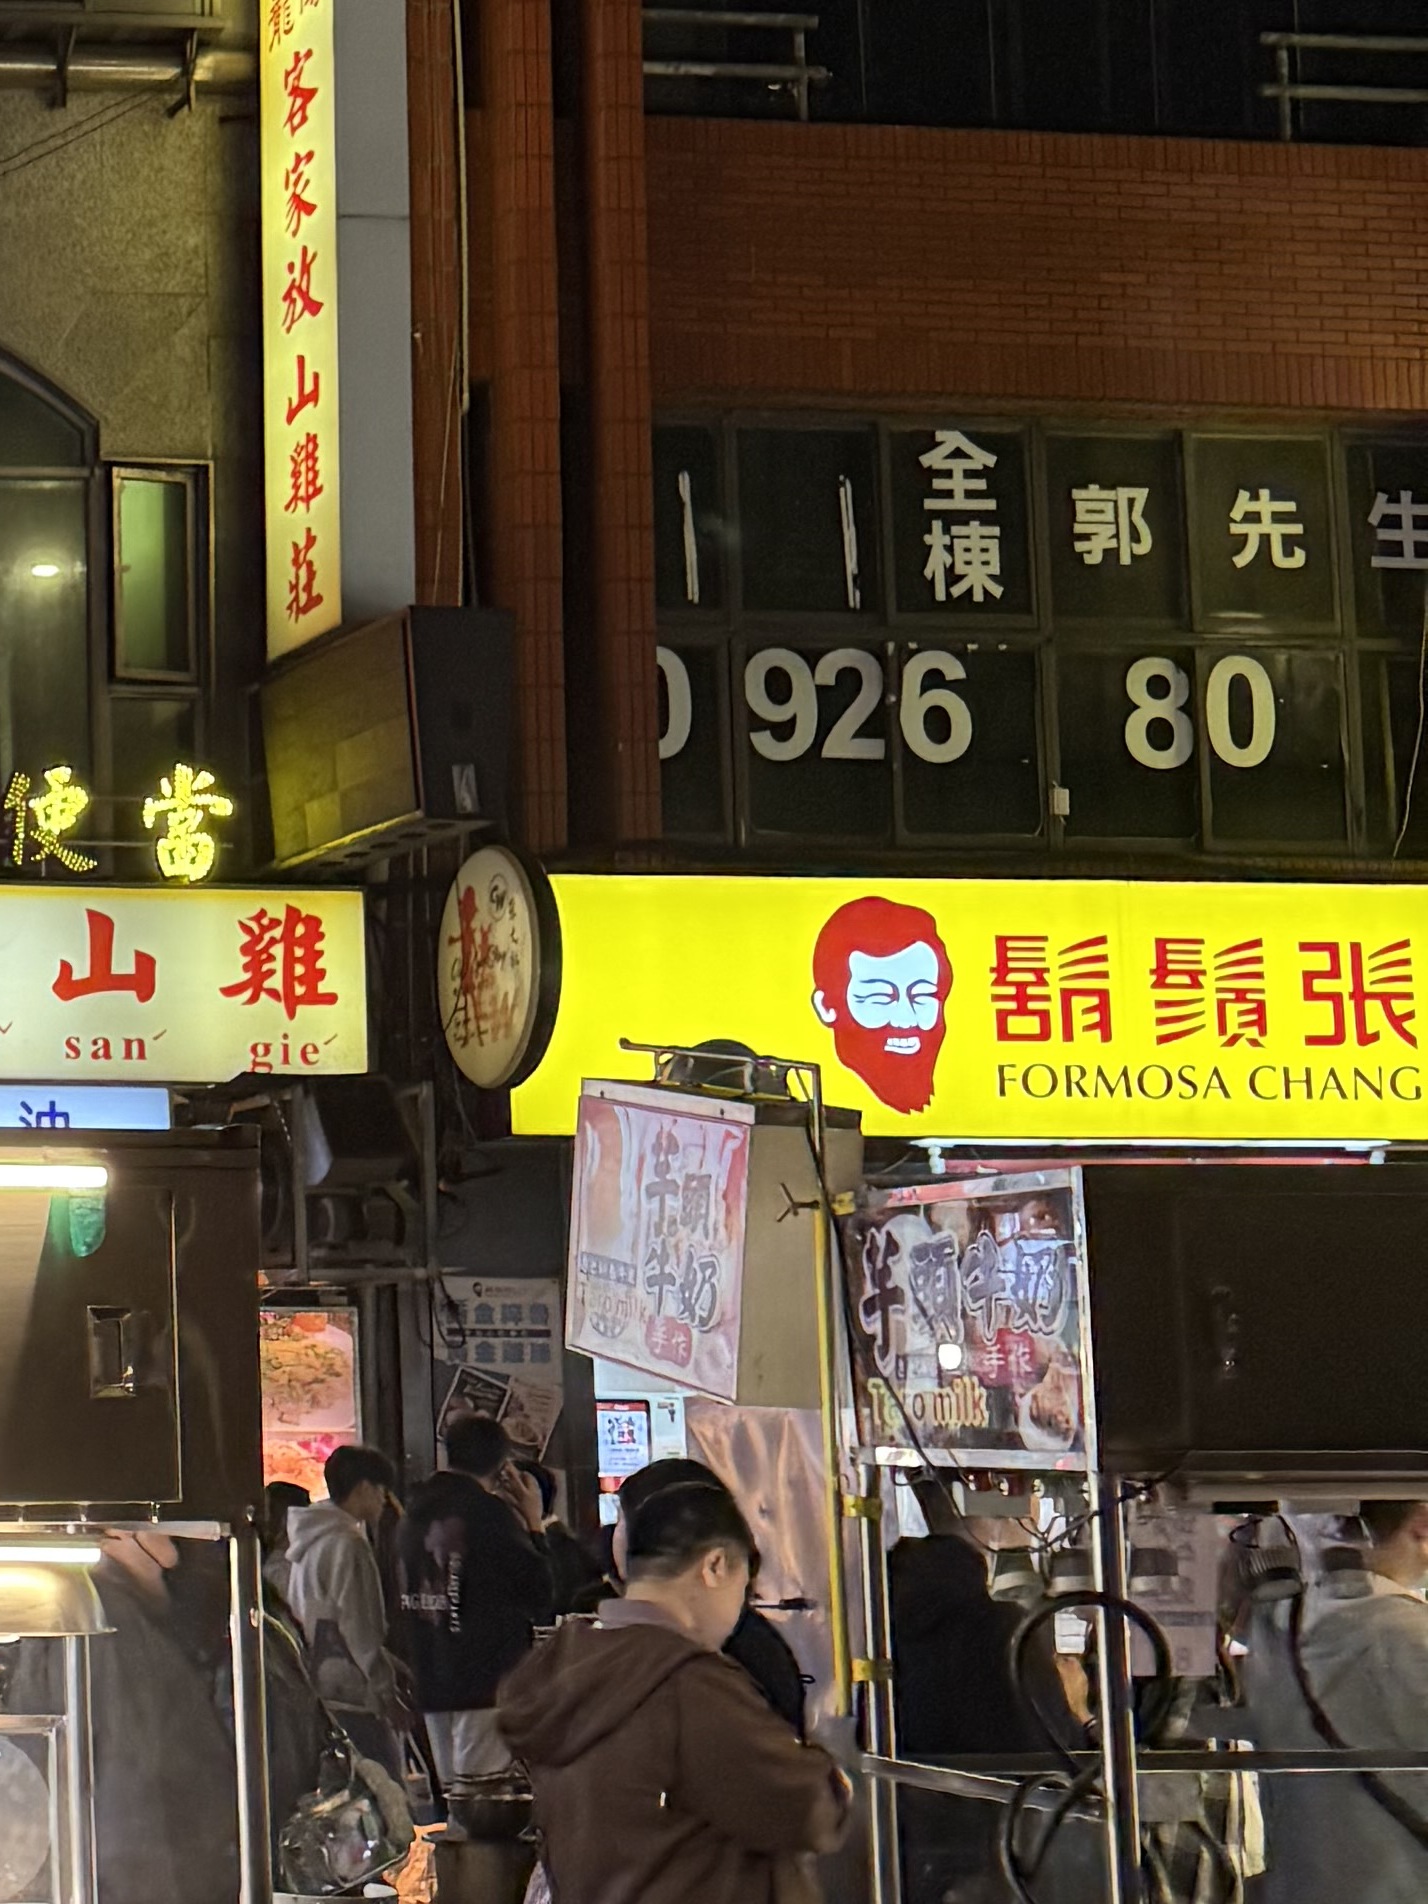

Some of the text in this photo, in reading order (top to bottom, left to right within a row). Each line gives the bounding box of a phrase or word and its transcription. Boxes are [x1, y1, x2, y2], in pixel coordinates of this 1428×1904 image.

[282, 48, 324, 624] 客家放山雞莊
[919, 430, 1004, 602] 全棟
[1071, 482, 1428, 570] 郭先生
[1125, 656, 1277, 770] 80
[5, 763, 233, 883] 便當
[989, 934, 1418, 1049] 鬍鬚張
[996, 1063, 1422, 1101] FORMOSA CHANG
